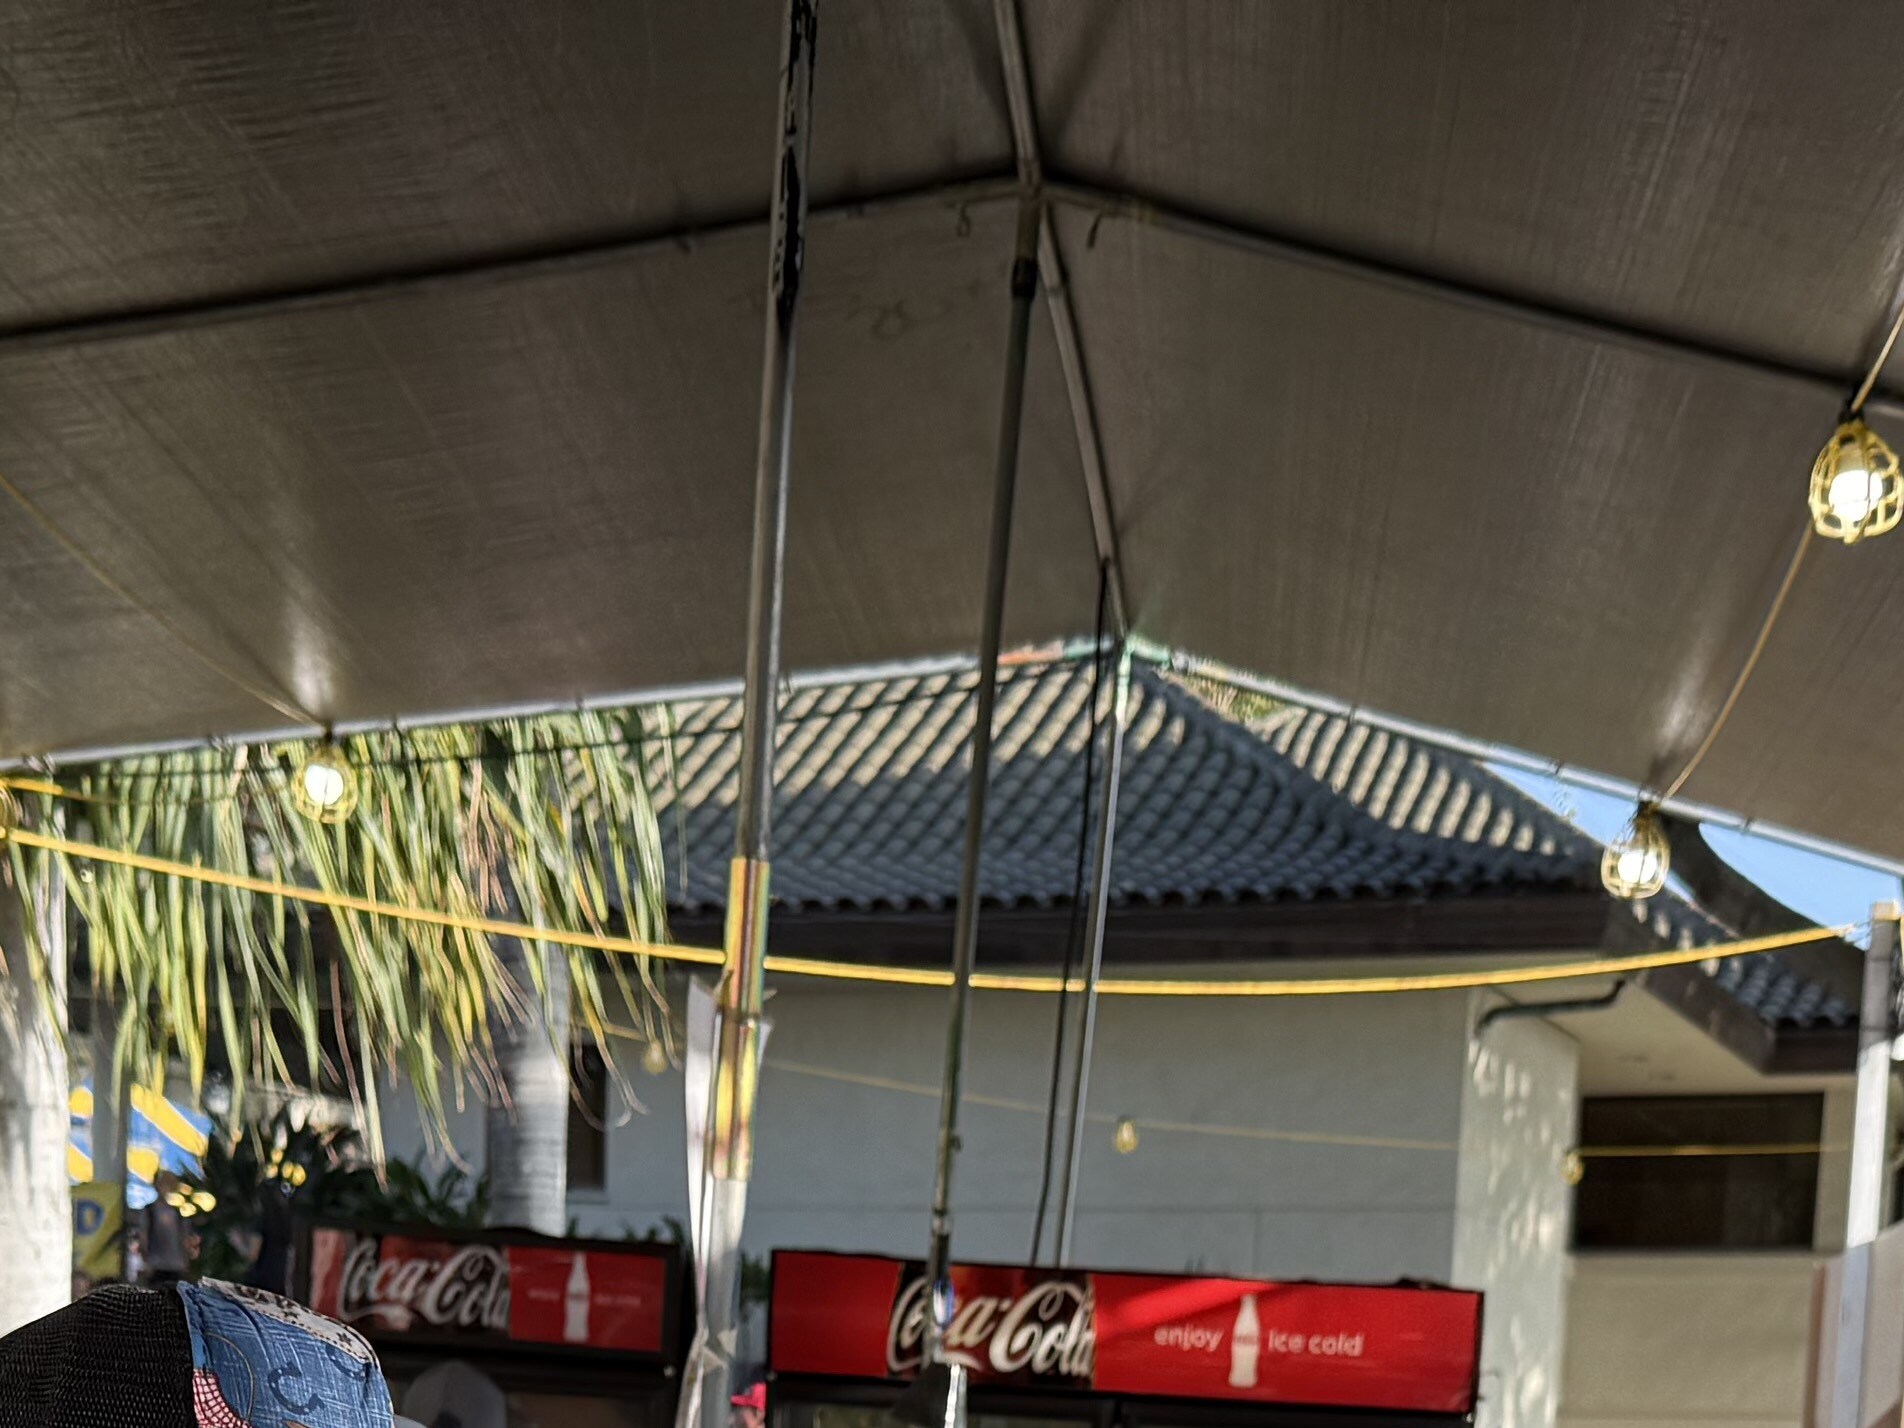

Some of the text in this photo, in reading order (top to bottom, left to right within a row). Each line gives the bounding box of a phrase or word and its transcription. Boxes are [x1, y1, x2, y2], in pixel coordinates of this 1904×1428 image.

[886, 1275, 1095, 1377] Coa-Cola
[1154, 1323, 1223, 1352] enjoy
[1308, 1331, 1364, 1357] cold
